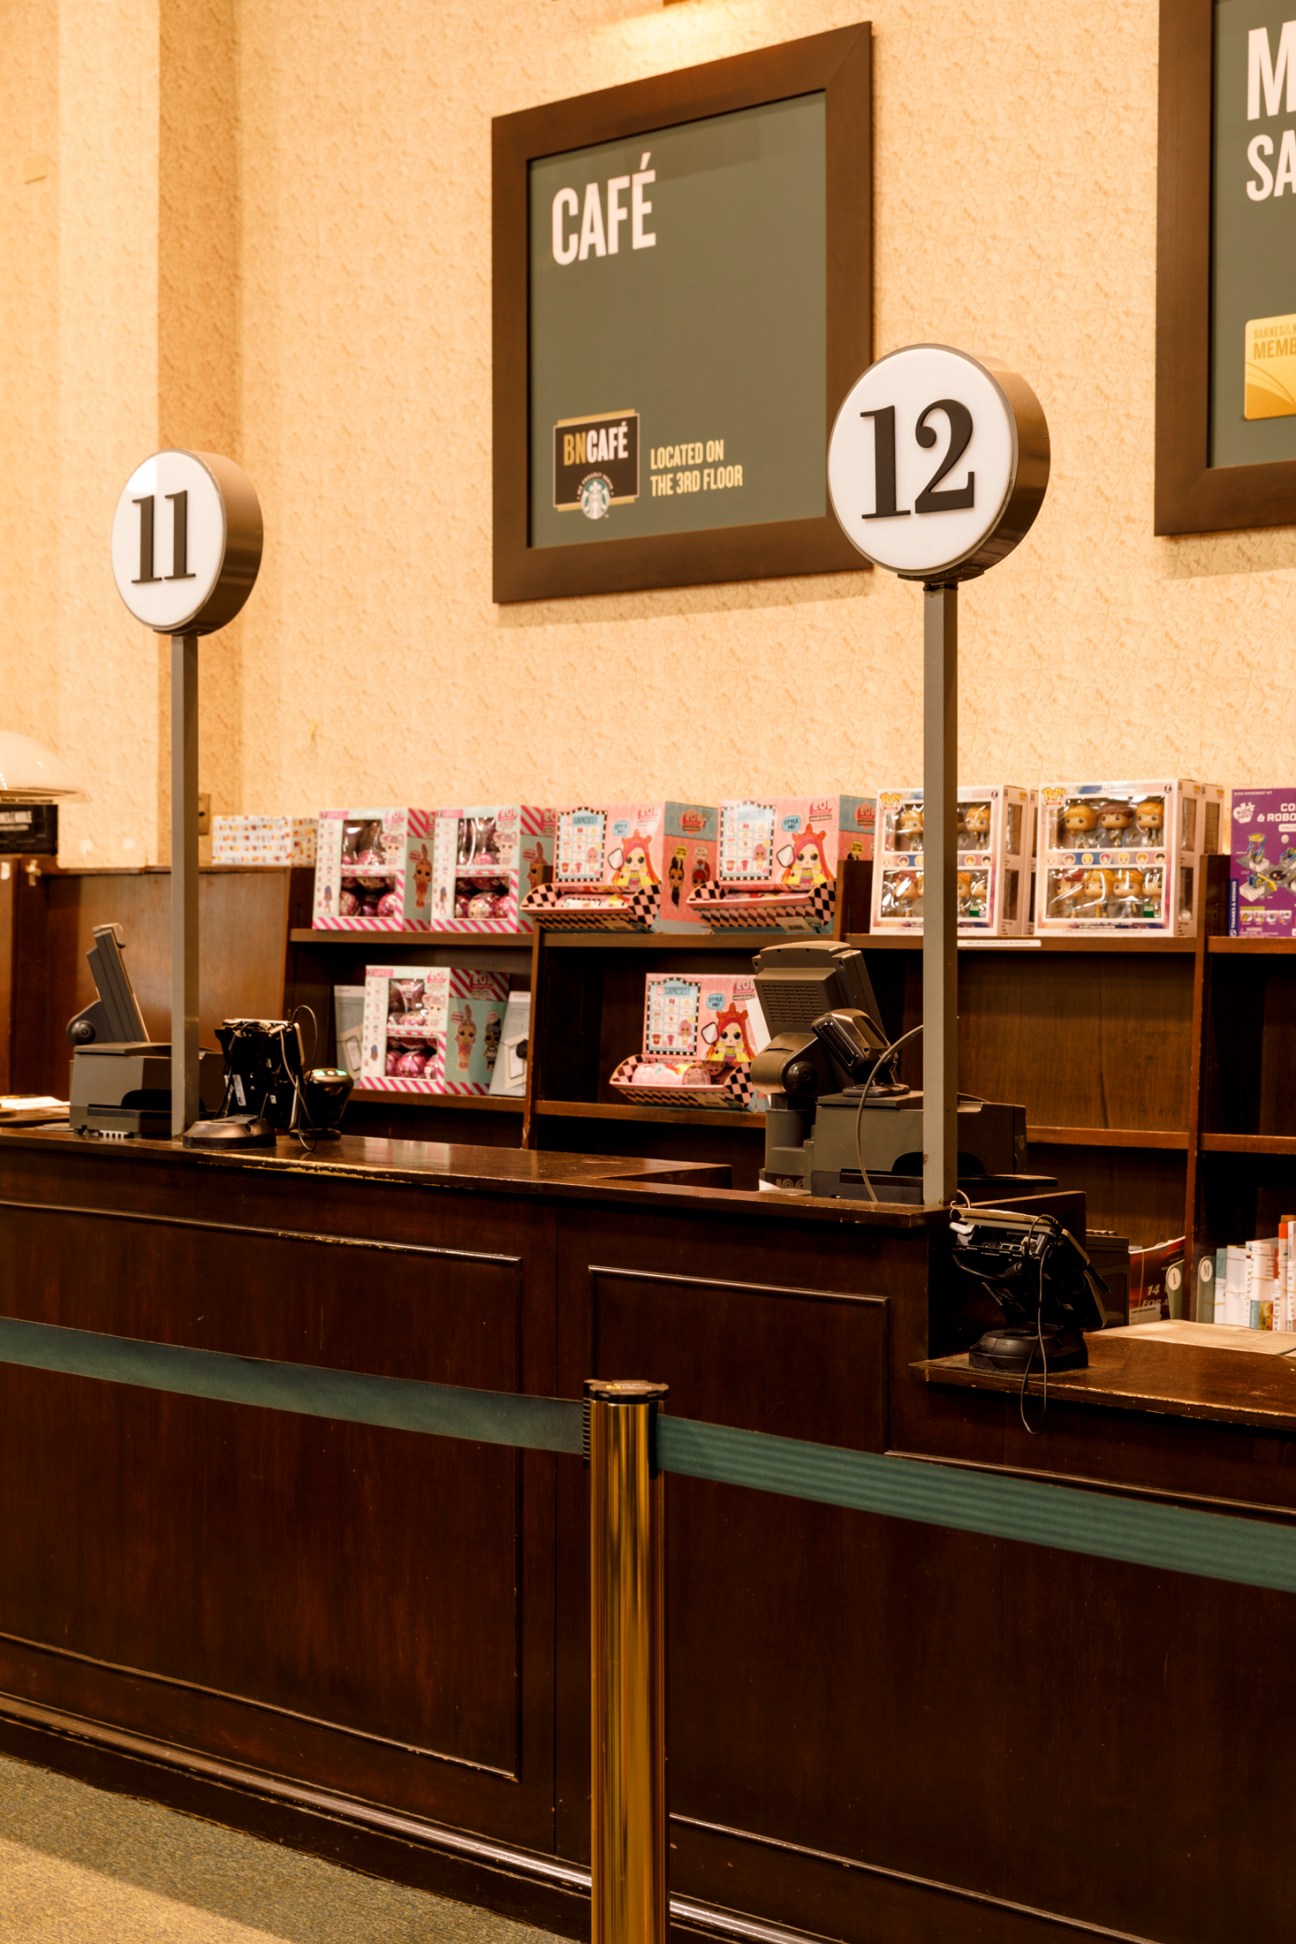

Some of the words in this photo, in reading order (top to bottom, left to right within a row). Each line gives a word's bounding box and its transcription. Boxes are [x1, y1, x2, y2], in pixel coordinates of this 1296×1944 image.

[552, 151, 656, 266] CAFÉ
[650, 441, 703, 470] LOCATED
[706, 439, 725, 463] ON
[650, 473, 674, 497] THE
[676, 470, 701, 494] 3RD
[703, 464, 743, 491] FLOOR
[859, 398, 975, 520] 12
[131, 489, 197, 584] 11
[1147, 1284, 1160, 1296] 14
